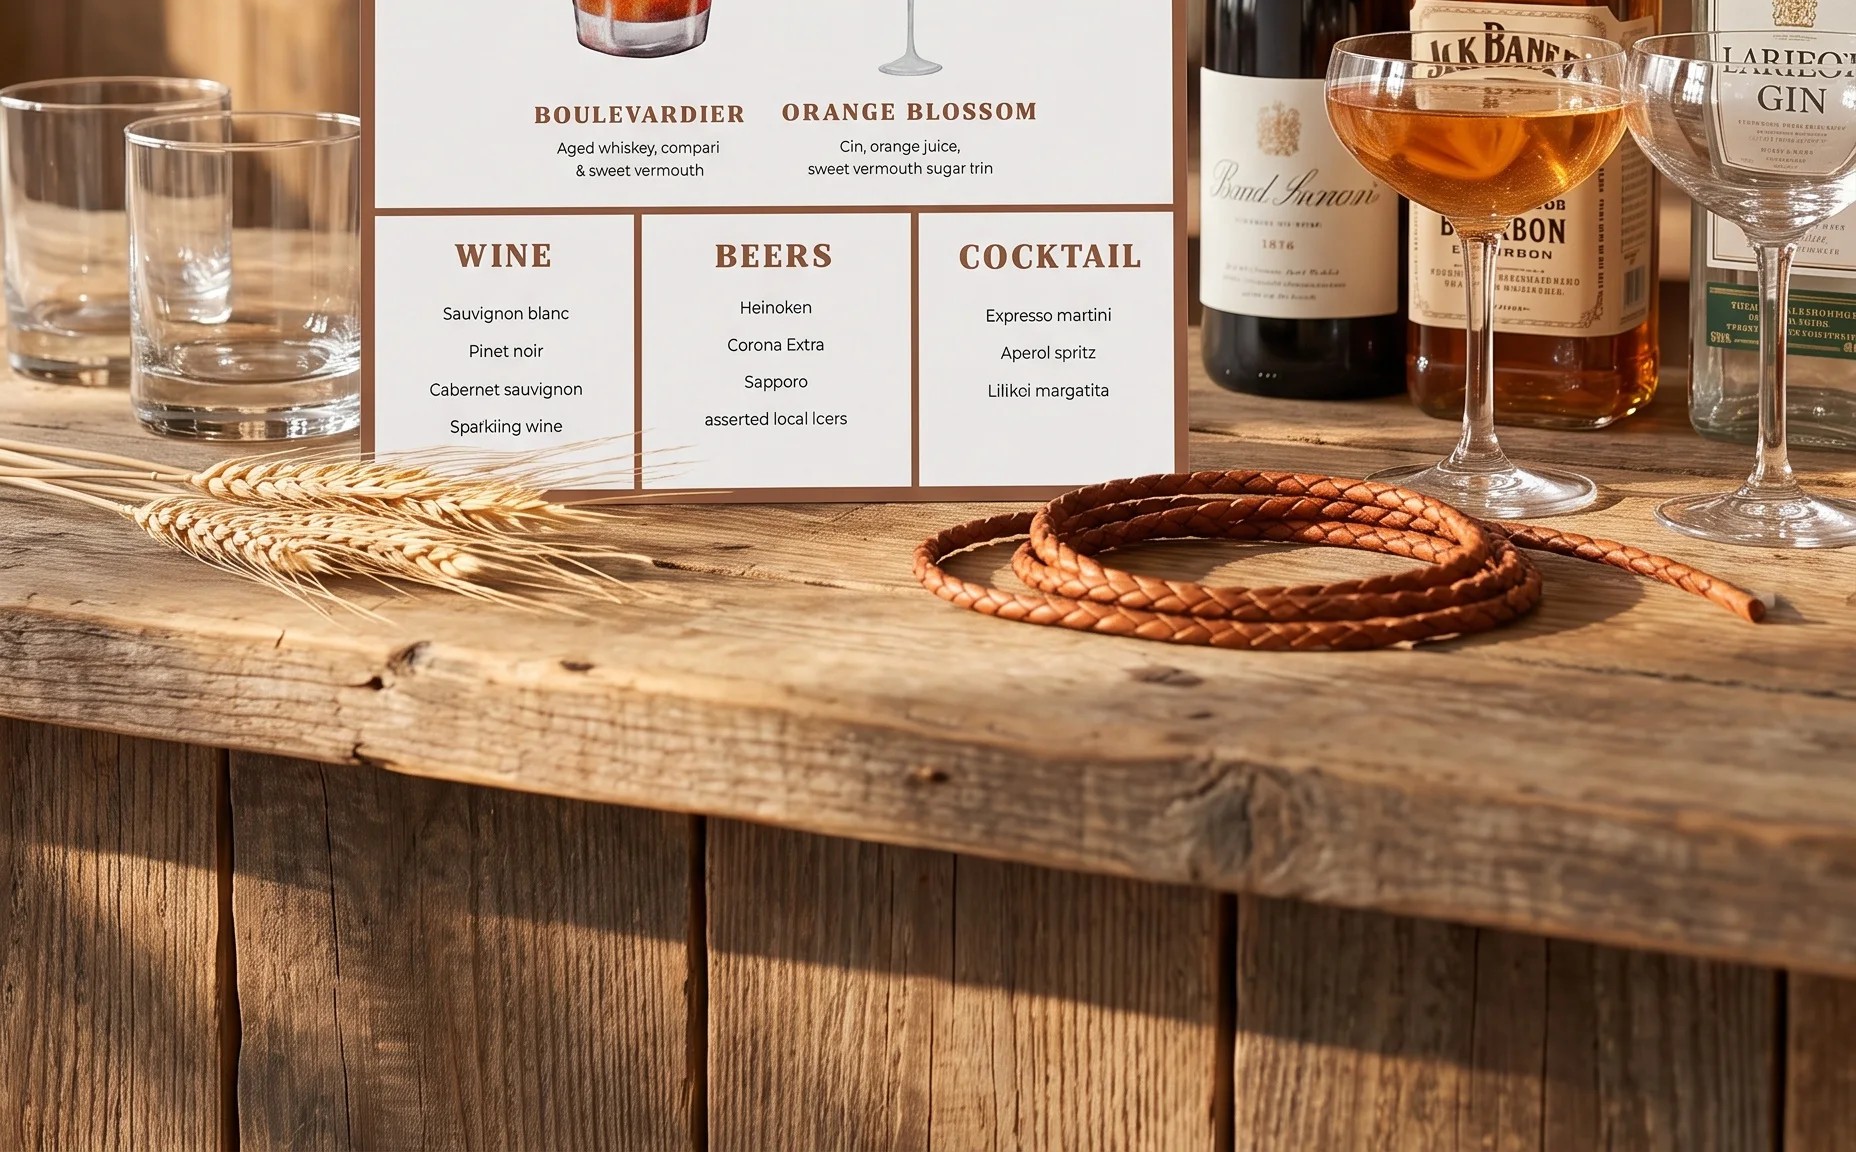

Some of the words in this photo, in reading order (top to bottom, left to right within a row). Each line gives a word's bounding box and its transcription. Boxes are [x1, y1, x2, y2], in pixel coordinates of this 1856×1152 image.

[1757, 84, 1828, 115] GIN
[534, 104, 745, 125] BOULEVARDIER
[781, 102, 895, 122] ORANGE
[906, 102, 1037, 121] BLOSSOM
[556, 141, 595, 158] Aged
[597, 140, 658, 158] whiskey,
[660, 140, 720, 157] compari
[869, 142, 920, 156] orange
[921, 138, 961, 156] juice,
[575, 164, 586, 178] &
[588, 164, 632, 177] sweet
[634, 163, 704, 177] vermouth
[807, 163, 850, 176] sweet
[852, 161, 923, 175] vermouth
[926, 164, 967, 178] sugar
[454, 243, 551, 268] WINE
[715, 243, 832, 268] BEERS
[959, 243, 1141, 270] COCKTAIL
[443, 305, 524, 324] Sauvignon
[528, 305, 570, 321] blanc
[740, 299, 812, 315] Heinoken
[986, 308, 1053, 326] Expresso
[1057, 307, 1112, 322] martini
[469, 343, 510, 358] Pinet
[513, 343, 544, 358] noir
[727, 337, 782, 352] Corona
[787, 337, 825, 352] Extra
[1000, 344, 1051, 363] Aperol
[1054, 344, 1097, 363] spritz
[429, 382, 501, 397] Cabernet
[503, 381, 583, 400] sauvignon
[744, 374, 809, 392] Sapporo
[525, 418, 563, 433] wine
[704, 411, 769, 427] asserted
[773, 411, 808, 426] local
